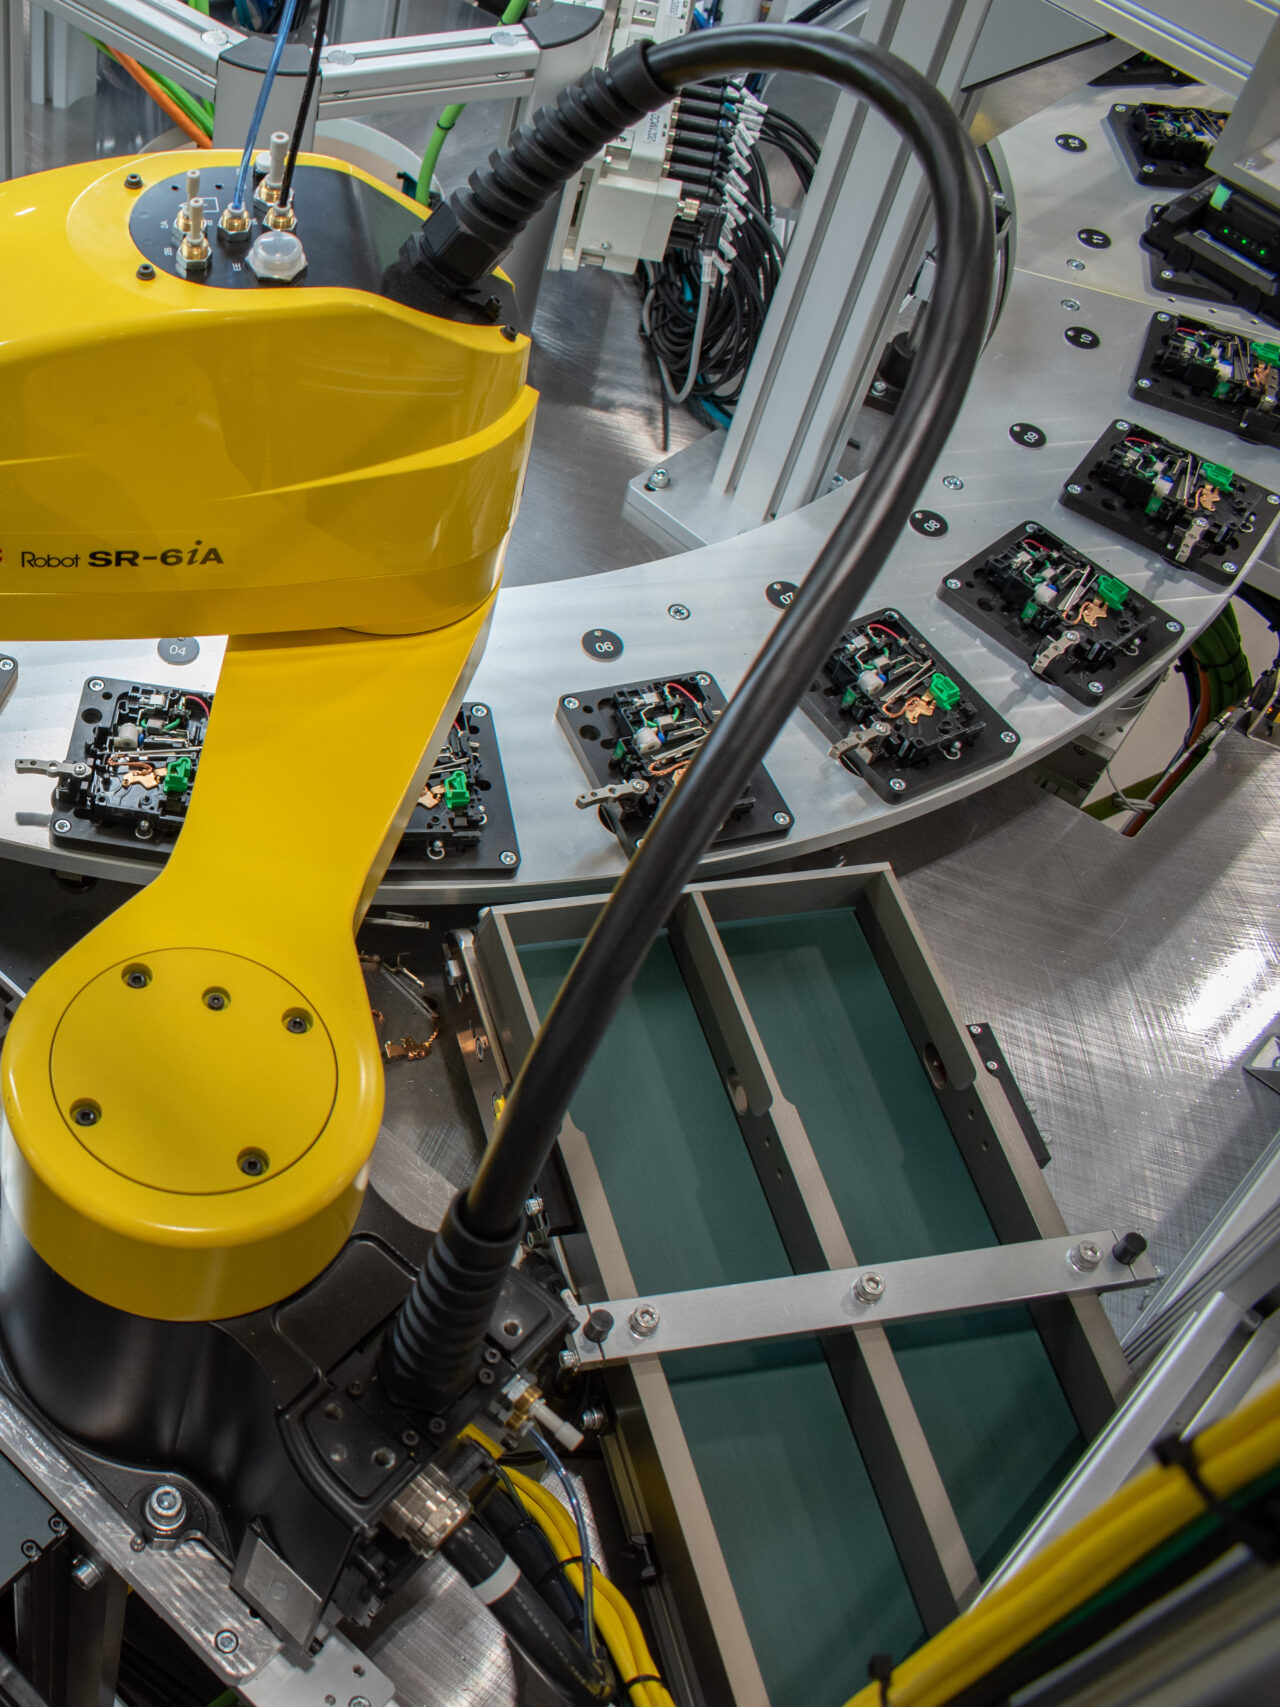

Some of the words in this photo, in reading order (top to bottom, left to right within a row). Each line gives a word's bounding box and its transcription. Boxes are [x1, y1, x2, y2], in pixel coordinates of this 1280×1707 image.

[1091, 234, 1105, 244] 11
[1079, 333, 1093, 344] 10
[1023, 431, 1039, 443] 09
[923, 519, 941, 532] 08
[21, 551, 81, 568] Robot
[87, 540, 224, 568] SR-6iA
[169, 644, 187, 656] 04
[595, 641, 614, 653] 06
